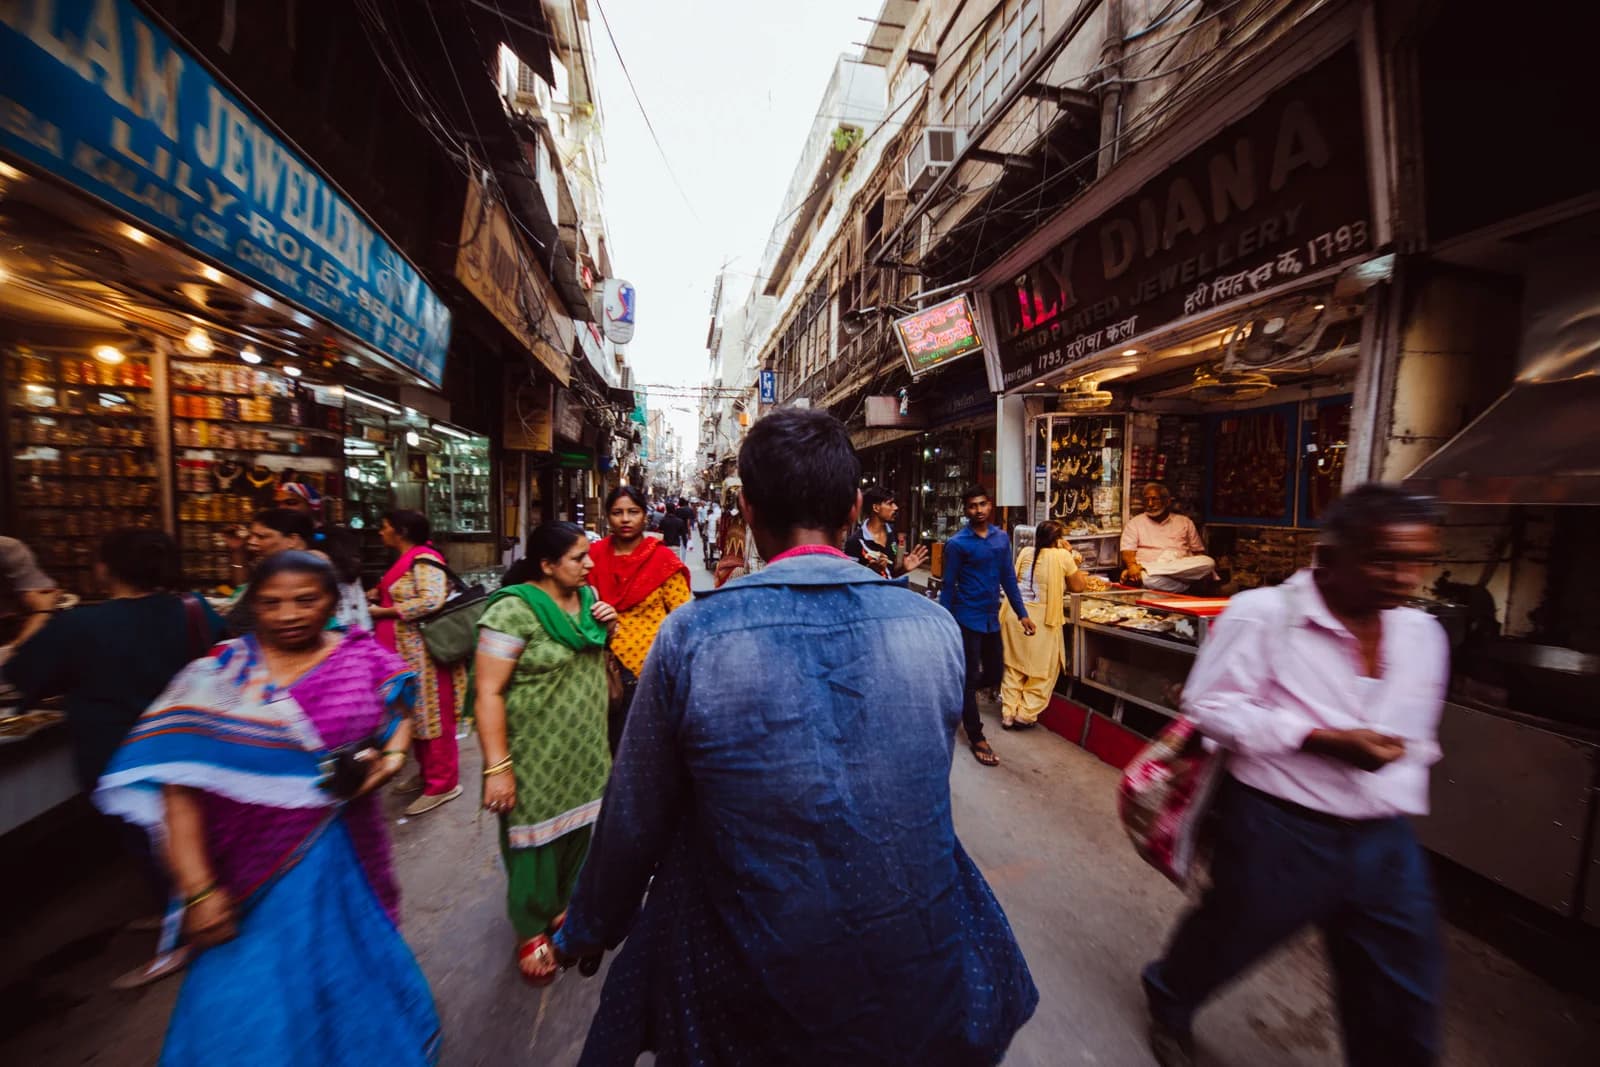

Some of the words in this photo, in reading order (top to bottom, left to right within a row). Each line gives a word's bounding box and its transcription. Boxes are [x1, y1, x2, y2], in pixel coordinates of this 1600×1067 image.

[194, 84, 375, 283] JEWELLERY
[1100, 101, 1331, 281] DIANA
[1129, 202, 1303, 307] JEWELLERY
[1307, 220, 1368, 265] 1793
[1038, 349, 1064, 369] 1793,
